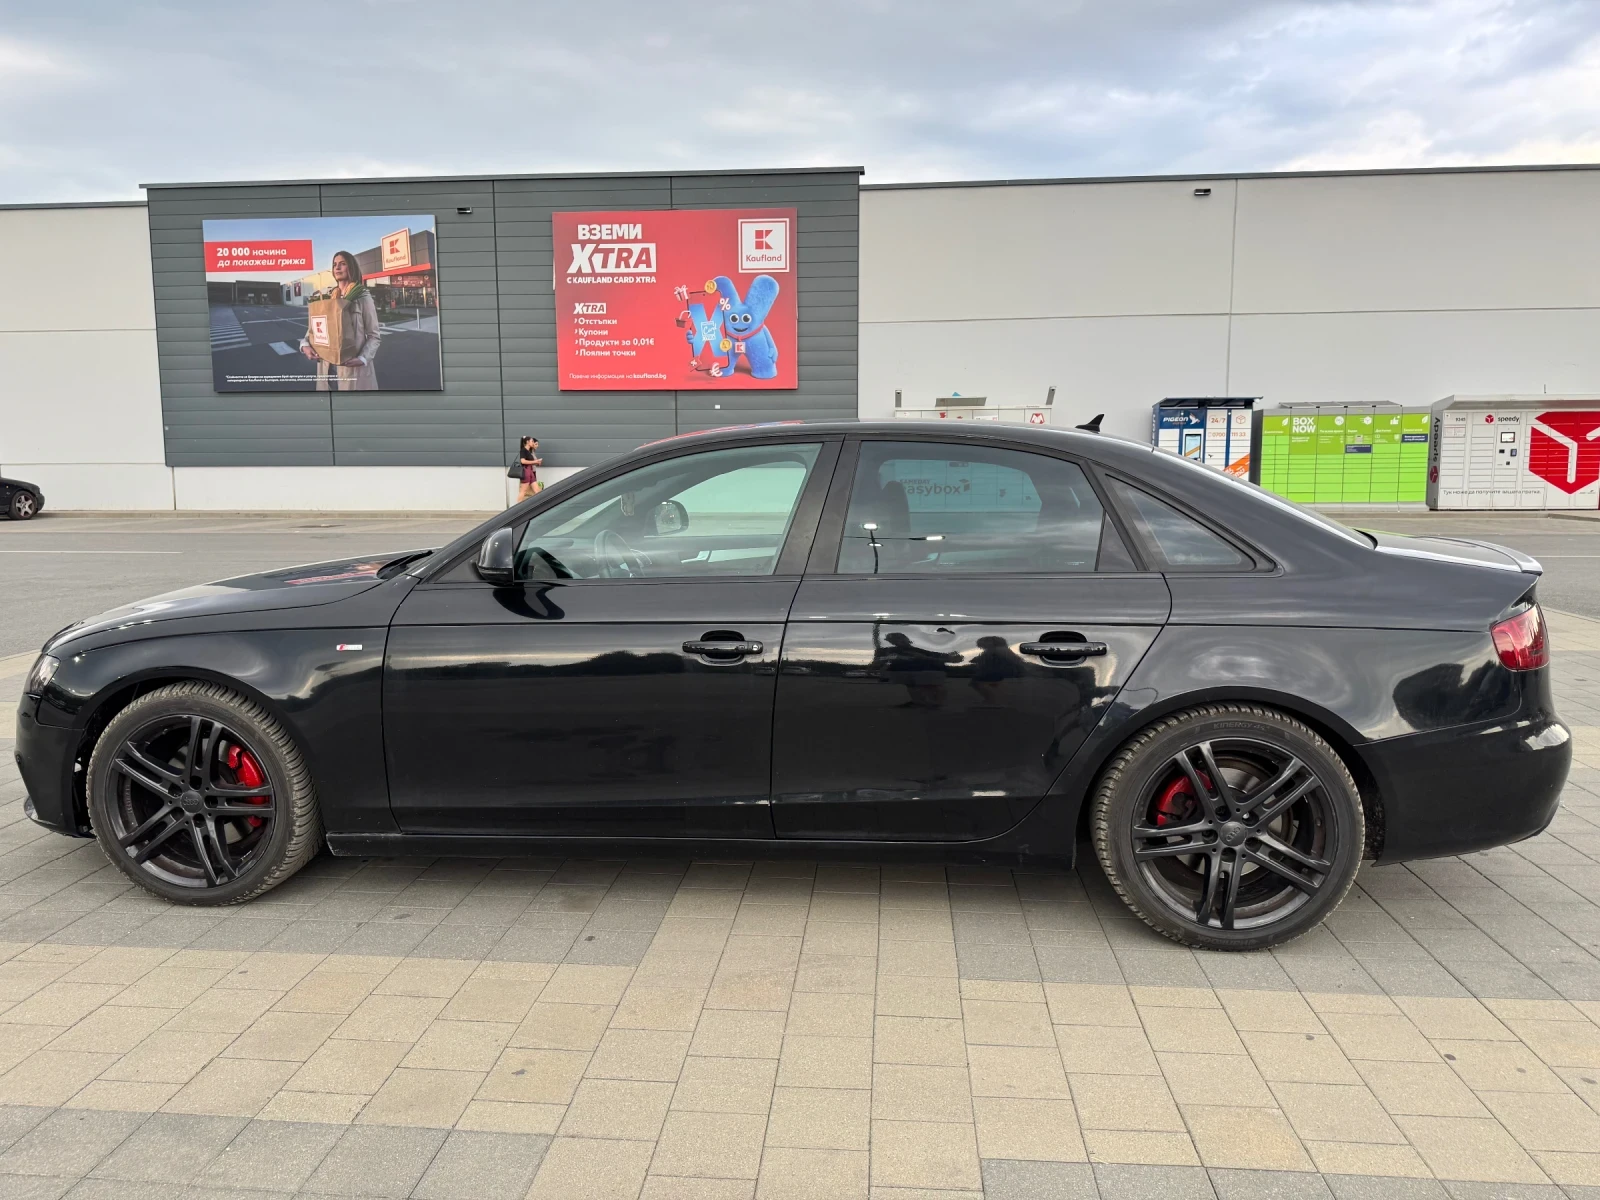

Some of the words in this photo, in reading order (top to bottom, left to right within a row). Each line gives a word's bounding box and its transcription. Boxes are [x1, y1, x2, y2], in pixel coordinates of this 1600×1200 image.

[577, 224, 642, 240] ВЗЕМИ
[216, 248, 229, 257] 20
[231, 247, 250, 257] 000
[566, 243, 656, 273] XTRA
[745, 254, 782, 262] Kaufland
[217, 260, 230, 268] да
[277, 258, 306, 267] грижа
[573, 303, 607, 315] XTRA
[578, 317, 617, 325] Отстъпки
[578, 328, 608, 337] Купони
[579, 339, 620, 347] Продукти
[632, 338, 655, 346] 0,01€
[1293, 417, 1314, 425] BOX
[1293, 425, 1316, 433] NOW
[904, 483, 961, 496] asybox
